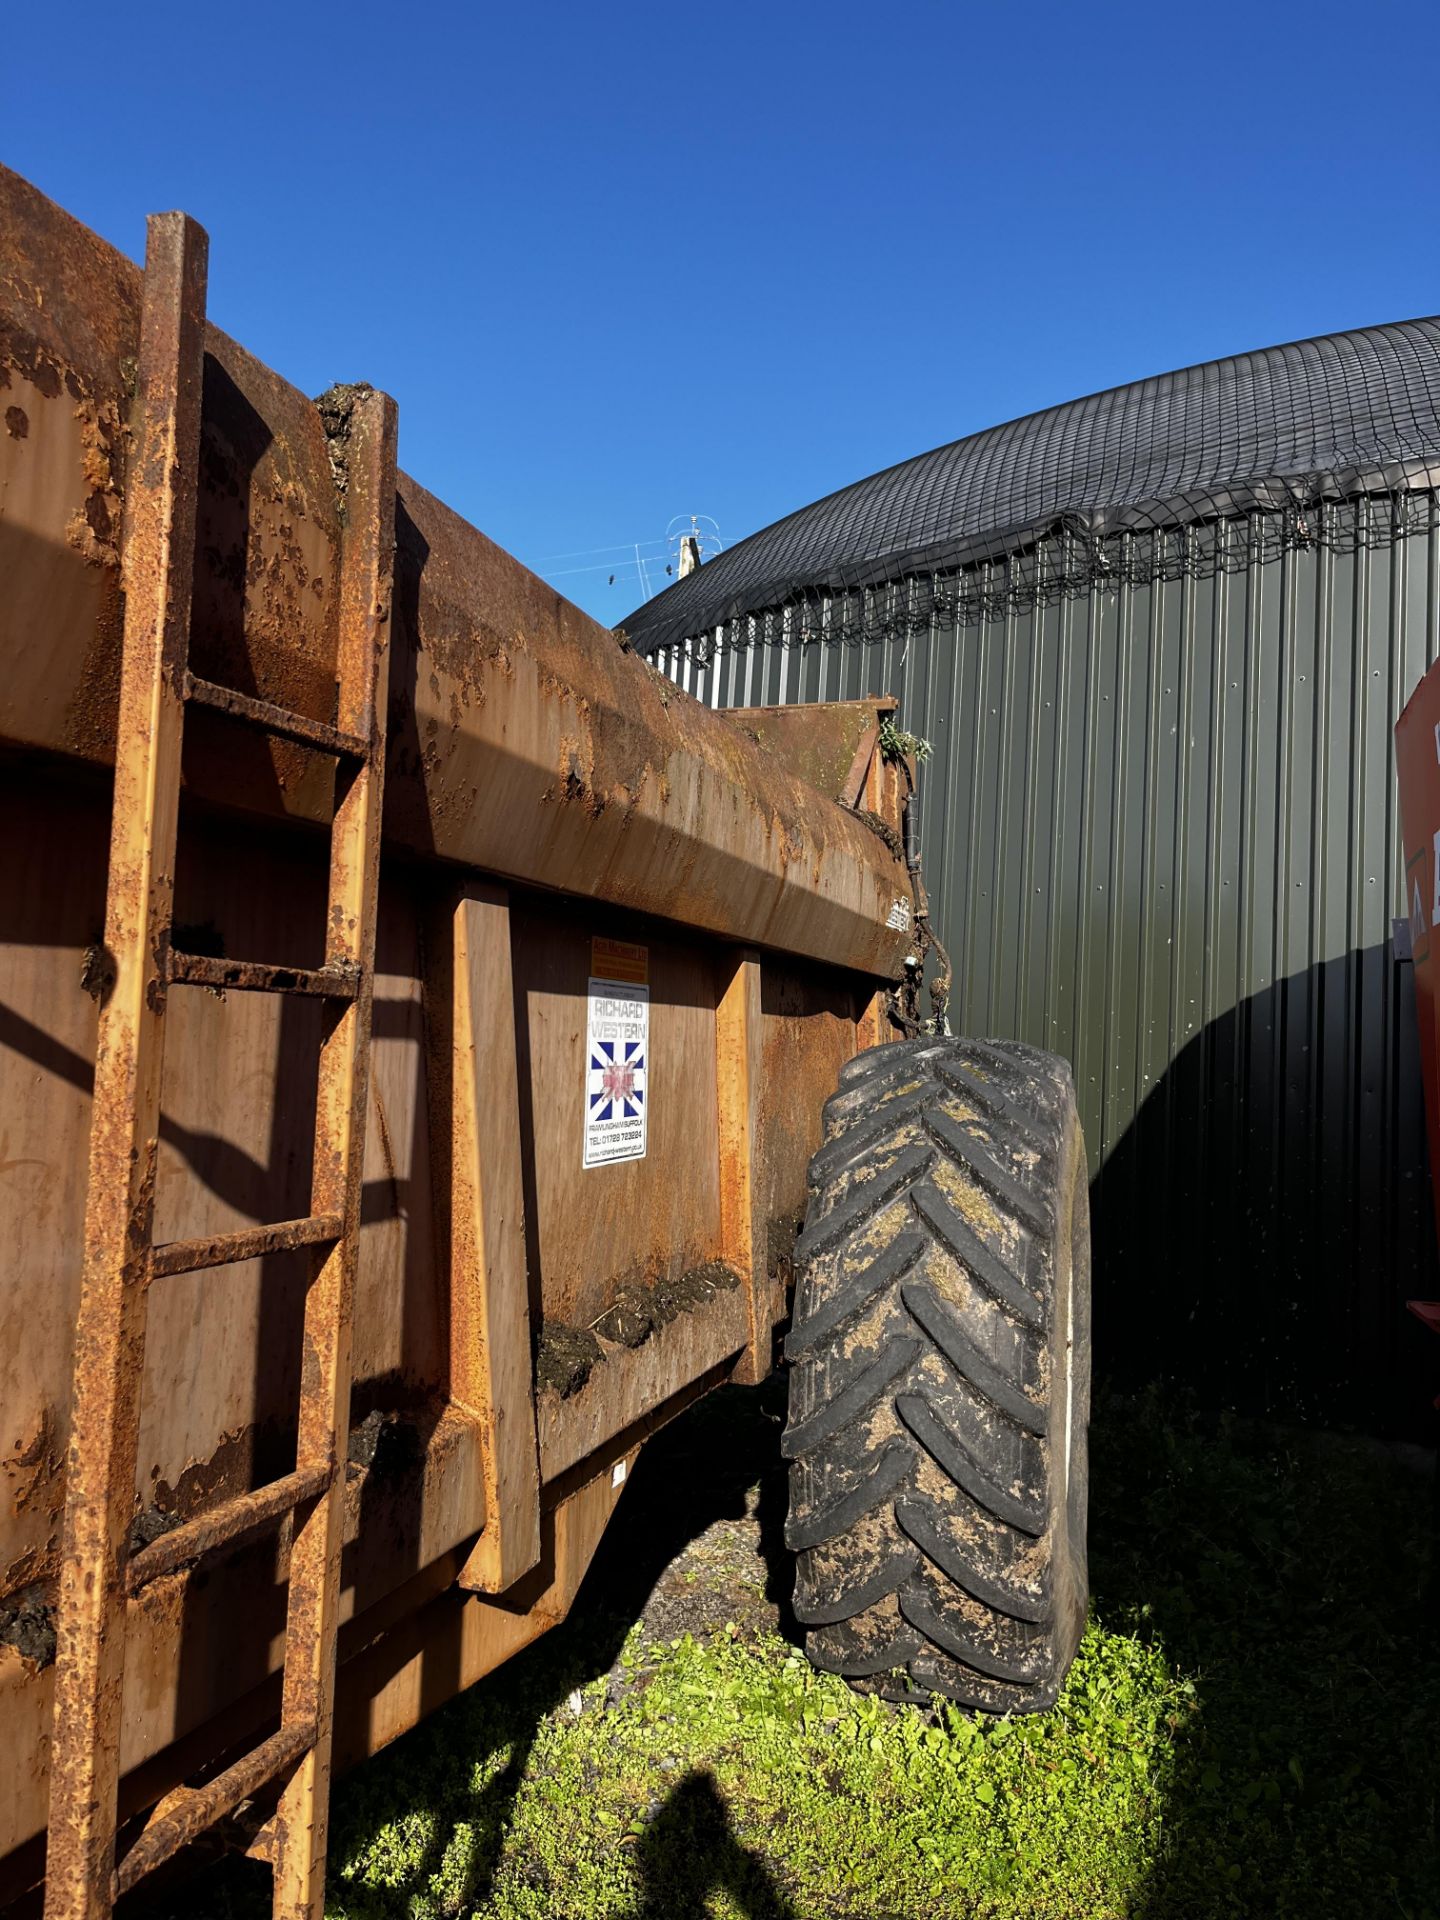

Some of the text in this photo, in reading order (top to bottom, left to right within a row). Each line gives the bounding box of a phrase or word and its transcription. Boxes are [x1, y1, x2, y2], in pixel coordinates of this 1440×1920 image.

[595, 1000, 643, 1018] RICHARD
[591, 1021, 646, 1039] WESTERN
[602, 1133, 620, 1144] 01728
[621, 1130, 641, 1140] 723224
